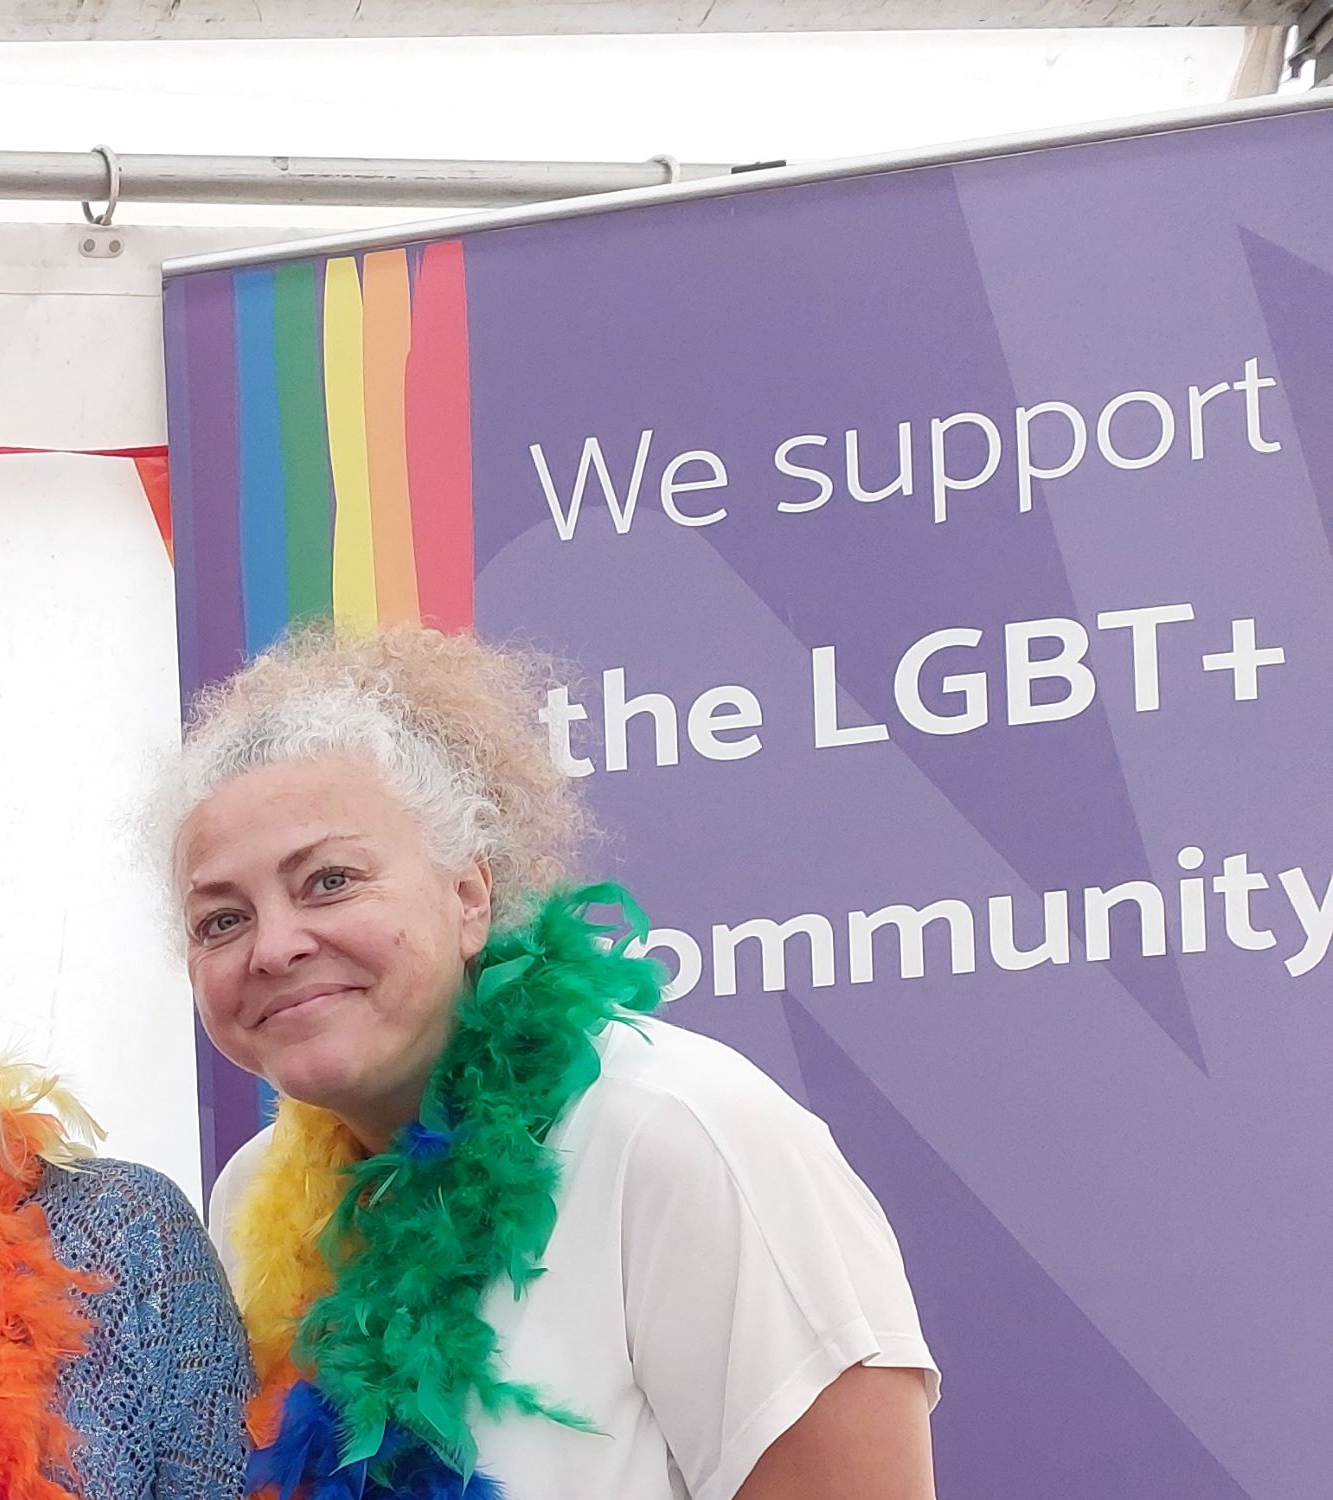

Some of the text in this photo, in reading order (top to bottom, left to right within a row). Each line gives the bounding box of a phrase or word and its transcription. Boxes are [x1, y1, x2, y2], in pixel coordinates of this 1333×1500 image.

[529, 357, 1282, 541] We support
[538, 602, 1286, 778] the LGBT+
